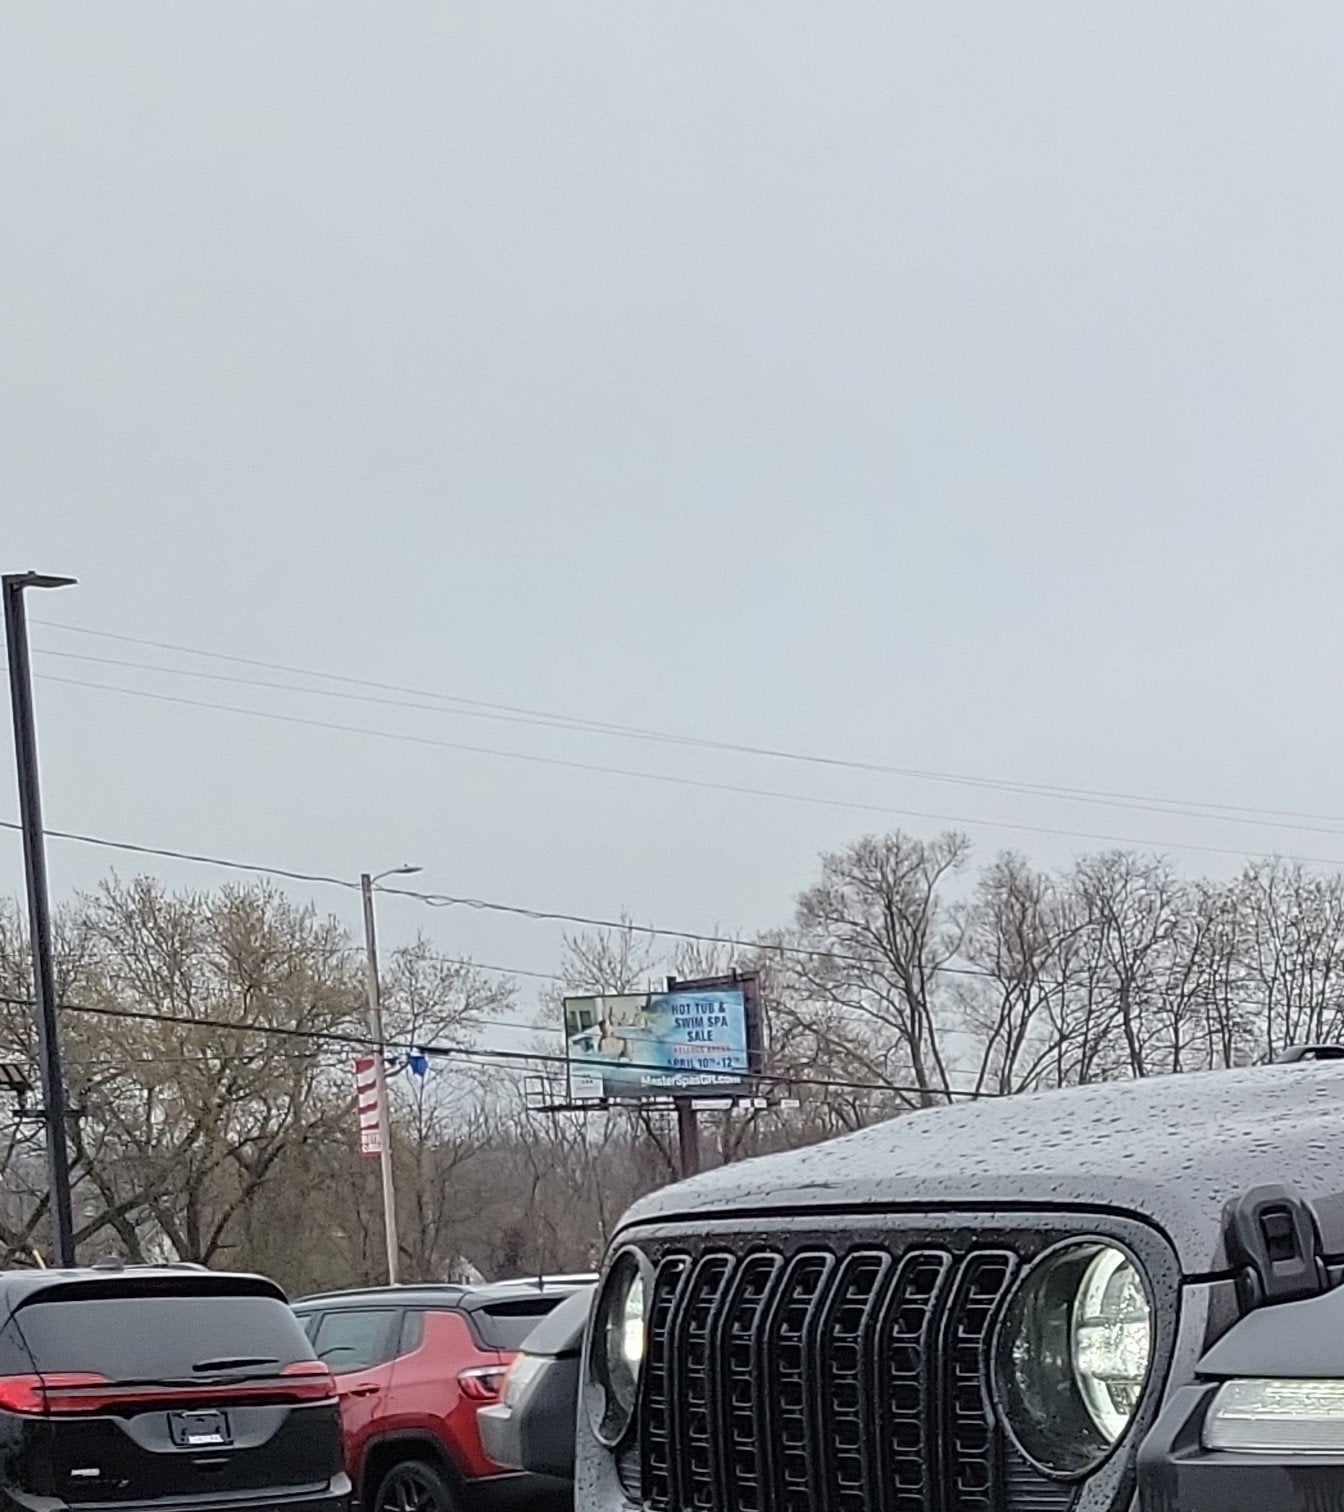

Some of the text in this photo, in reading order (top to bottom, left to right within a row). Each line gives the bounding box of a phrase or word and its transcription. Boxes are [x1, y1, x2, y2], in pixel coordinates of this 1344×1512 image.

[671, 1001, 726, 1015] HOT TUB &
[674, 1015, 729, 1029] SWIM SPA
[687, 1029, 714, 1042] SALE
